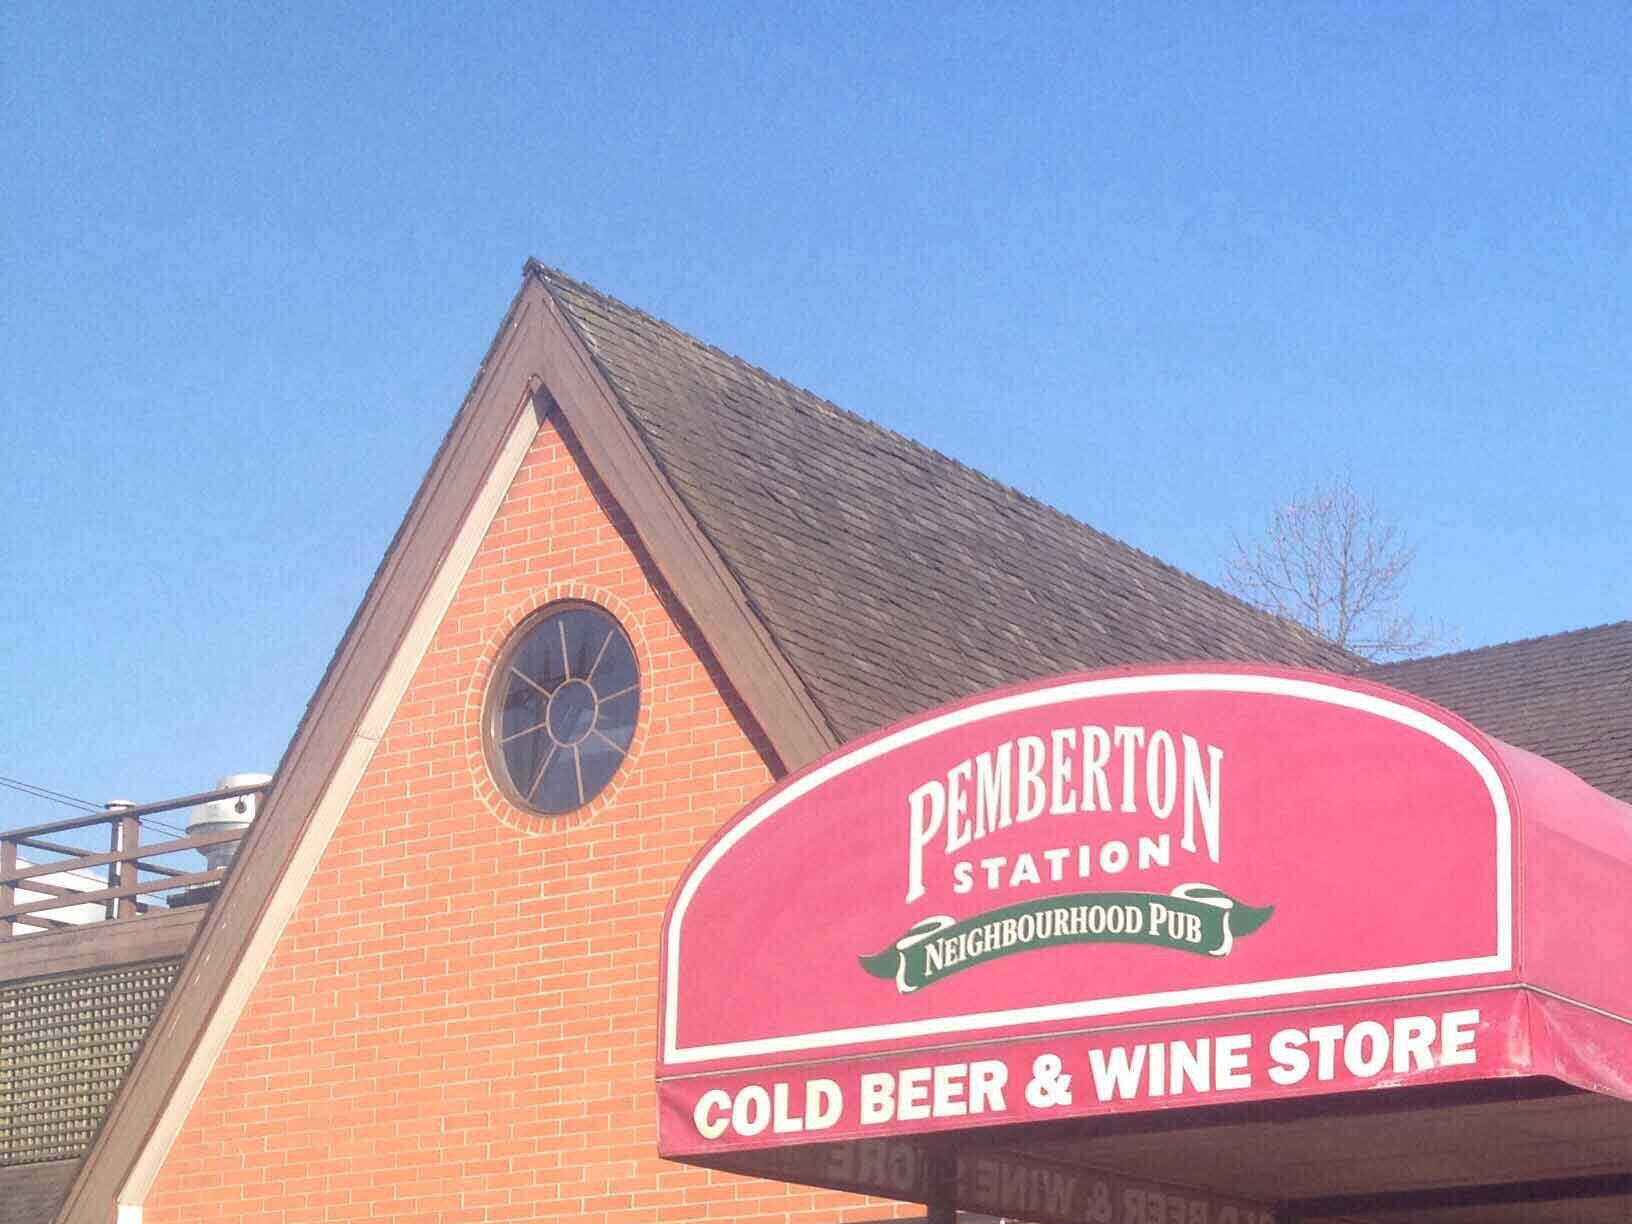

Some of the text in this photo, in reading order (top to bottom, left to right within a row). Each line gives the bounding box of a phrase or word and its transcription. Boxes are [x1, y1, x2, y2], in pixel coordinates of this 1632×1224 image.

[906, 725, 1224, 904] PEMBERTON
[953, 834, 1170, 894] STATION
[924, 902, 1202, 977] NEIGHBOURHOOD PUB
[693, 1008, 1481, 1140] COLD BEER & WINE STORE
